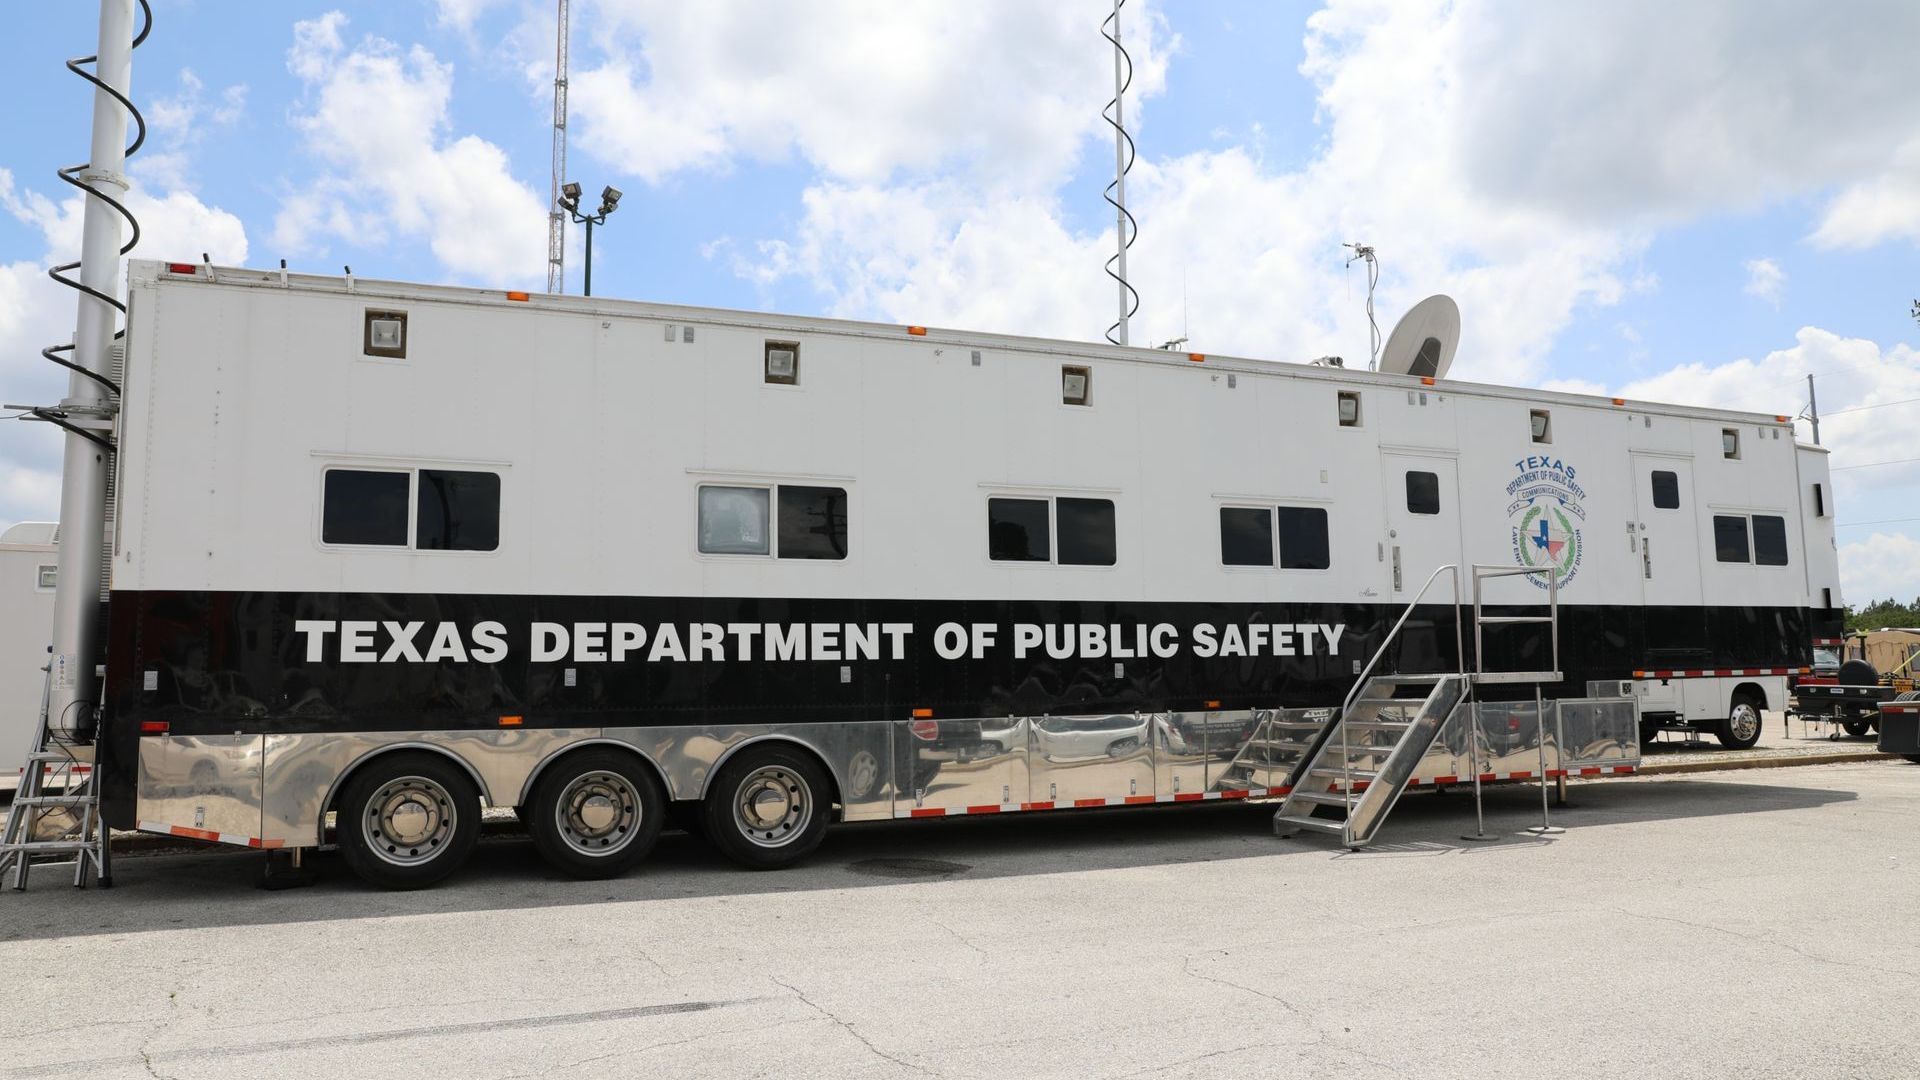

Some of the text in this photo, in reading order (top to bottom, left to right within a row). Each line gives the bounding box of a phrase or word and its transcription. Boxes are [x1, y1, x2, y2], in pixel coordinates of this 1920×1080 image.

[1515, 456, 1576, 479] TEXAS
[1506, 471, 1586, 501] DEPARTMENT OF PUBLIC SAFETY
[1521, 487, 1569, 501] COMMUNICATIONS
[1575, 529, 1583, 566] DIVISION
[295, 620, 1346, 663] TEXAS DEPARTMENT OF PUBLIC SAFETY
